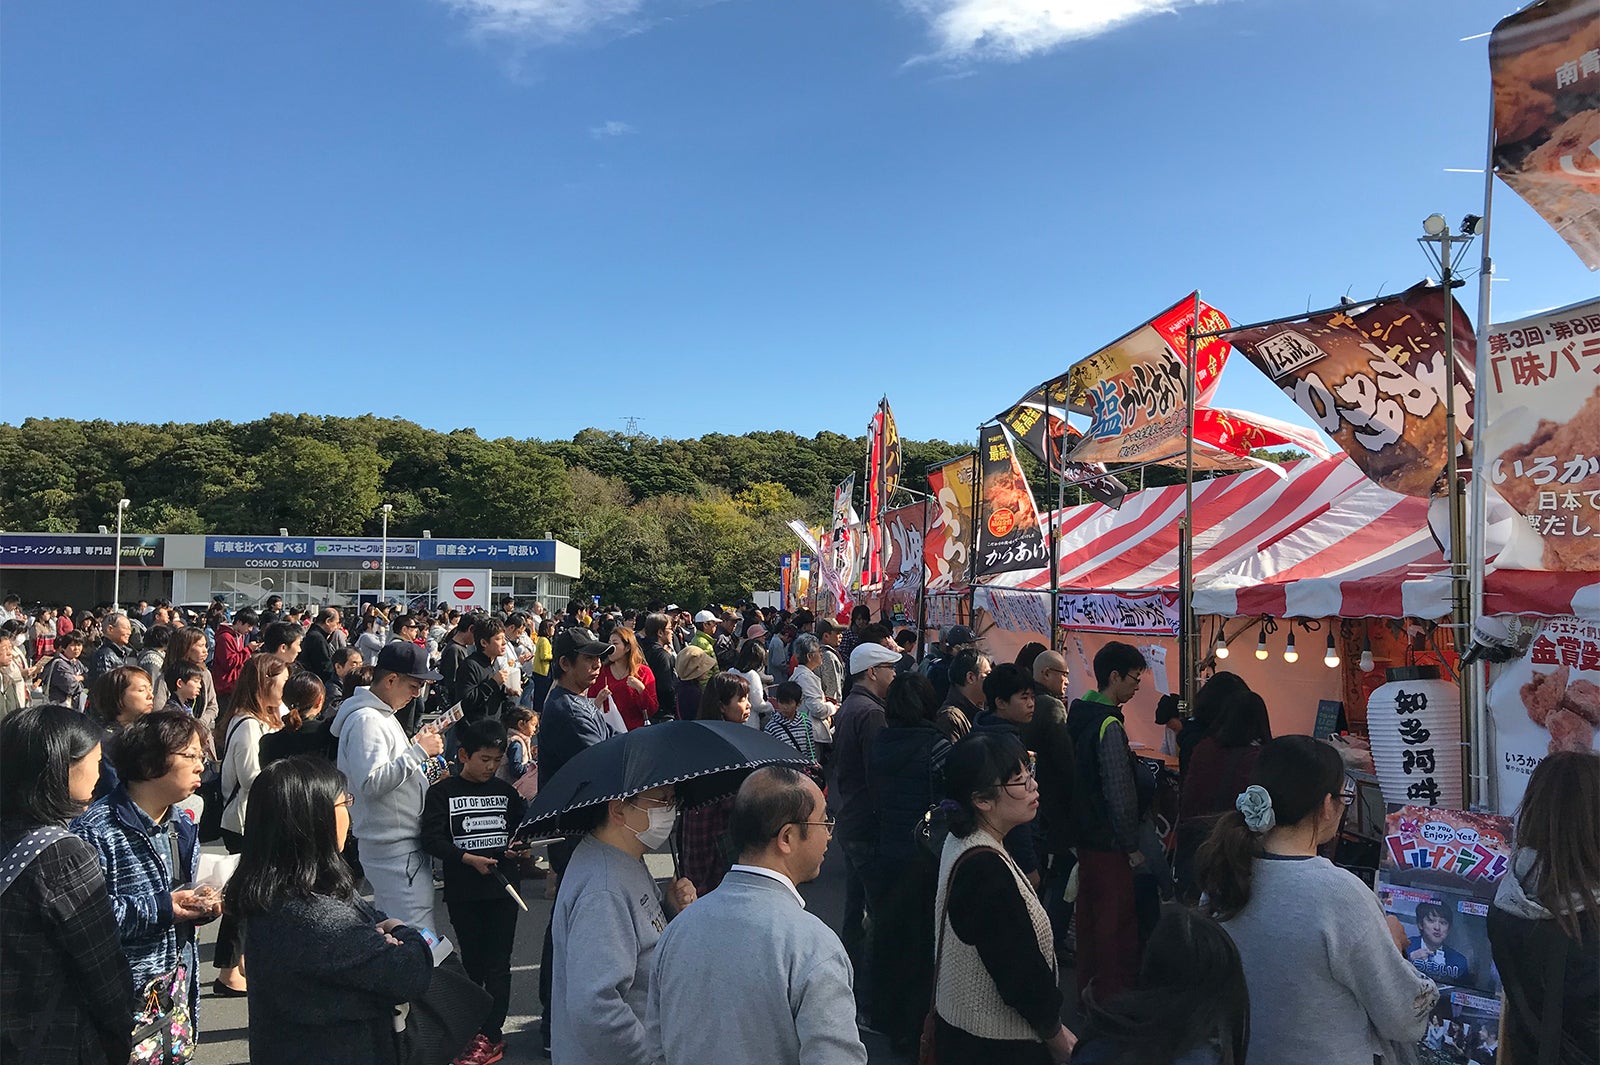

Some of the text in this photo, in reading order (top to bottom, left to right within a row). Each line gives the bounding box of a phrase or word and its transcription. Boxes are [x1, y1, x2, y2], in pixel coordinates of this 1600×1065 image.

[1264, 335, 1318, 372] 伝説の
[989, 443, 1010, 462] 最高
[1539, 489, 1600, 511] 日本で
[436, 544, 539, 556] 国産全メーカー取扱い
[245, 559, 319, 568] COSMO STATION
[453, 799, 467, 809] LOT
[469, 798, 479, 807] OF
[1439, 825, 1451, 833] you
[1423, 831, 1454, 841] Enjoy?
[1456, 832, 1478, 842] Yes!
[1387, 835, 1508, 881] ヒルナンデス!
